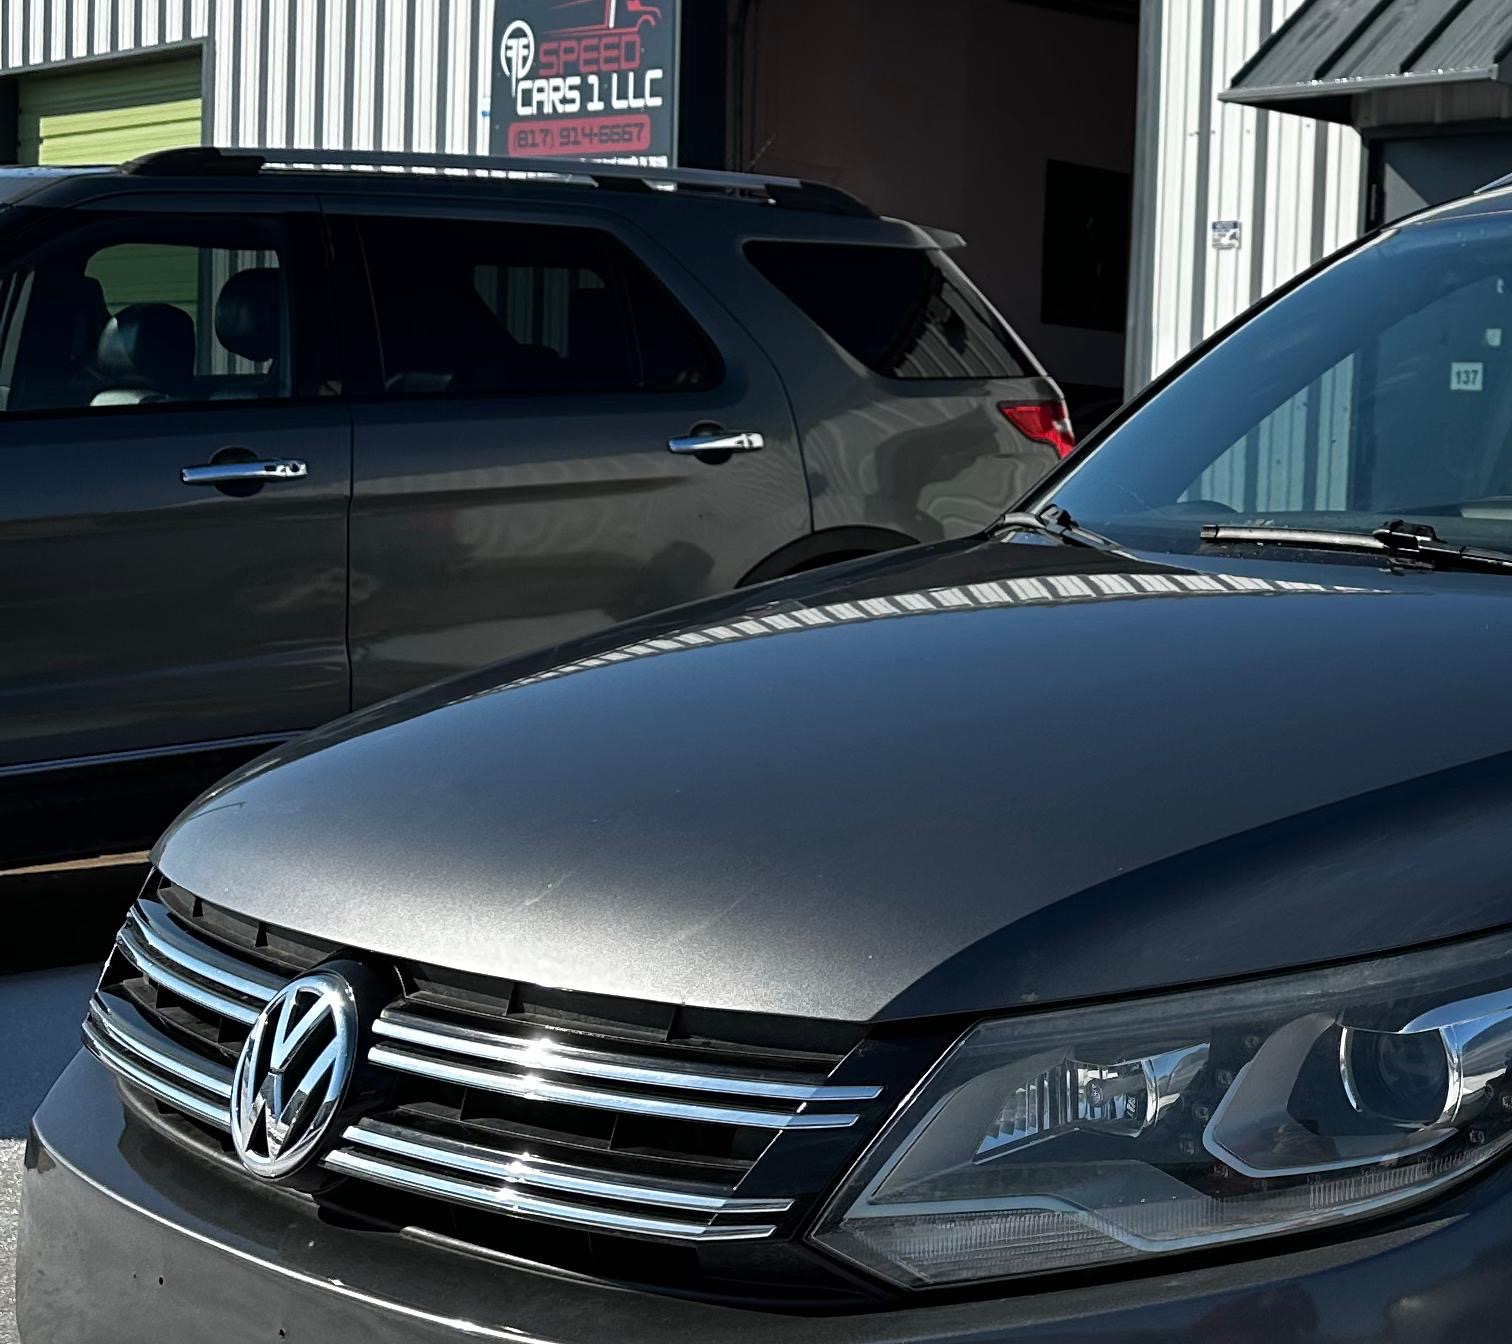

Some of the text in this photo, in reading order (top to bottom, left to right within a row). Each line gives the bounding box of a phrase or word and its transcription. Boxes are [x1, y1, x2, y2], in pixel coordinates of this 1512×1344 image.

[538, 33, 641, 77] SPEED
[516, 68, 663, 116] CARS 1 LLC
[513, 128, 554, 151] (817)
[1455, 369, 1479, 385] 137
